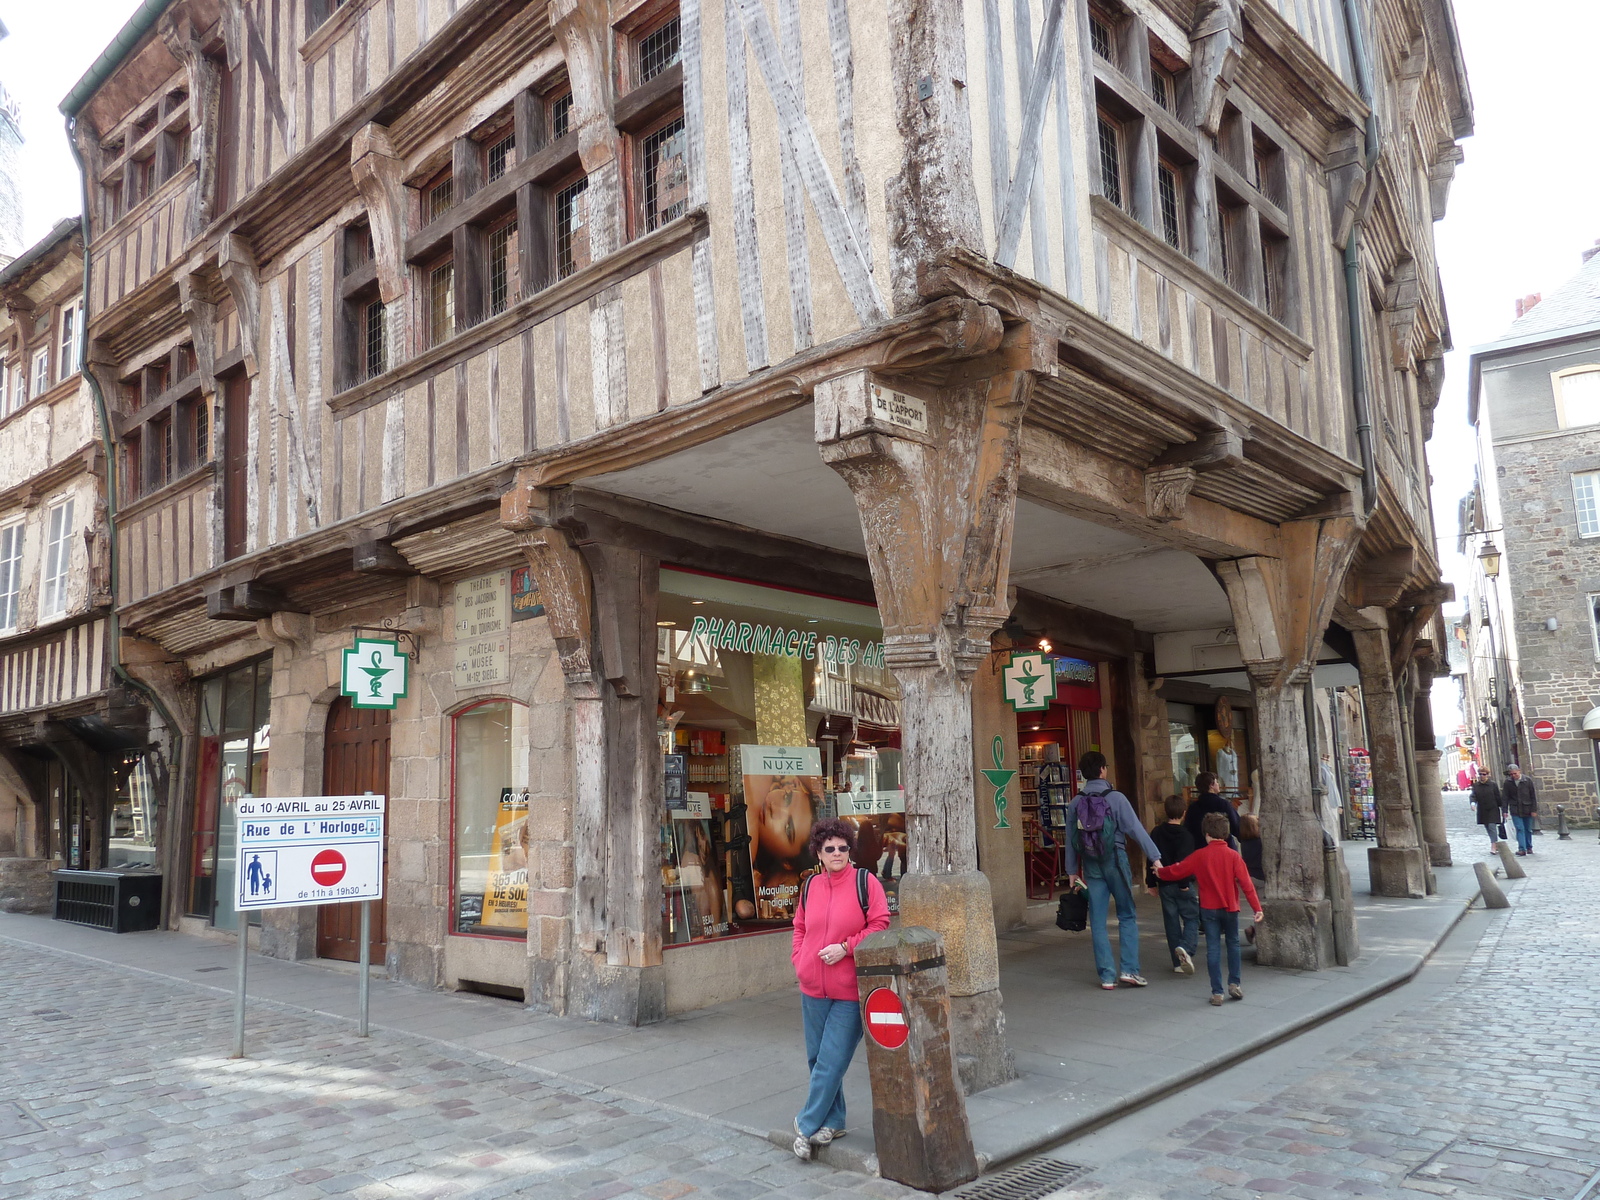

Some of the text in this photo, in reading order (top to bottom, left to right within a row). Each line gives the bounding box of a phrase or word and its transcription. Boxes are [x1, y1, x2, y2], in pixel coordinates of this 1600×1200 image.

[893, 393, 905, 403] RUE
[877, 398, 922, 421] DE L'APPORT
[897, 417, 911, 426] DINAN
[465, 591, 497, 607] DES JACOBINS
[477, 606, 495, 620] OFFICE
[470, 620, 501, 635] DU TOURISME
[689, 616, 818, 660] PHARMACIE
[824, 635, 860, 666] DES
[1064, 661, 1096, 682] ARCADES
[763, 760, 804, 770] NUXE
[240, 800, 381, 814] du 10 AVRIL au 25 AVRIL
[851, 801, 892, 810] NUXE
[246, 824, 270, 836] Rue
[280, 823, 295, 835] de
[492, 874, 510, 887] 365
[298, 890, 309, 898] de
[328, 888, 334, 896] à
[336, 886, 360, 895] 19h30
[493, 886, 528, 901] DE SOL
[759, 884, 799, 896] Maquillage
[702, 914, 714, 925] BEAU
[703, 921, 729, 936] PAR NATURE
